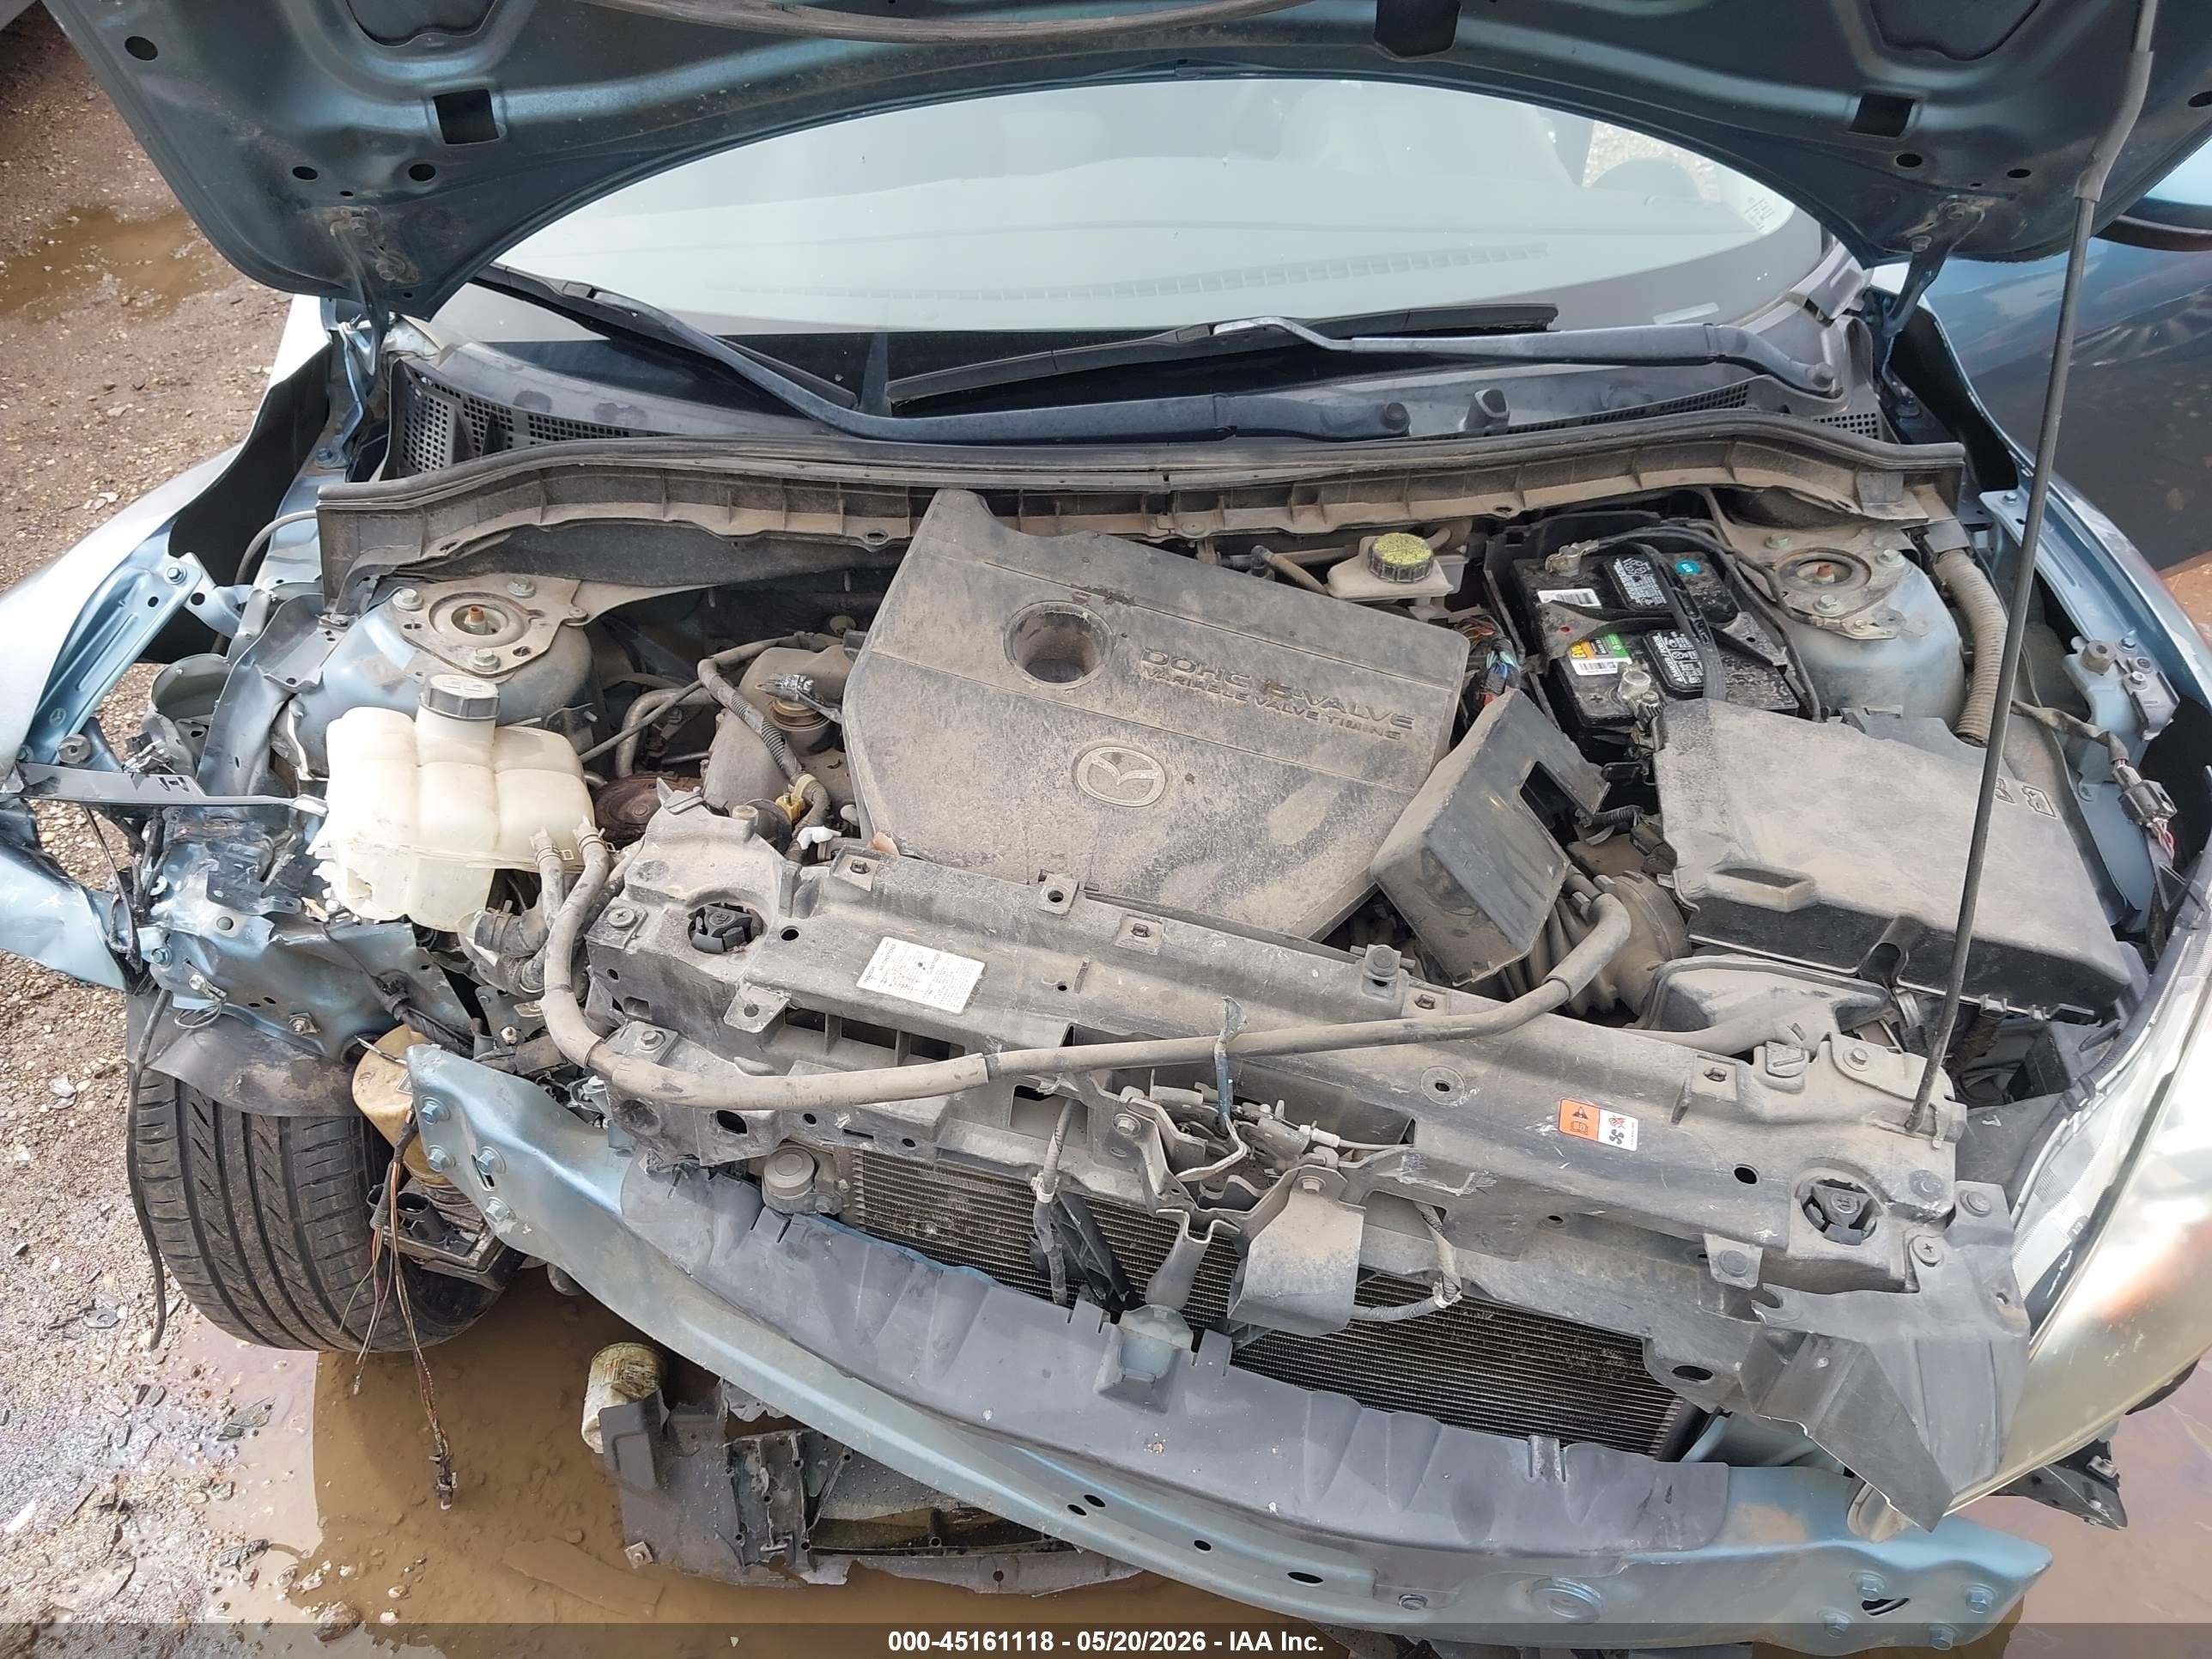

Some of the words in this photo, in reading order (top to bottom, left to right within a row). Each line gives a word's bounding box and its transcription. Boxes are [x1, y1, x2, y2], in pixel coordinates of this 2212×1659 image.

[1141, 647, 1251, 688] DOHC
[1145, 668, 1249, 702] VARIABLE
[1254, 696, 1320, 721] VALVE
[1327, 714, 1401, 741] TIMING
